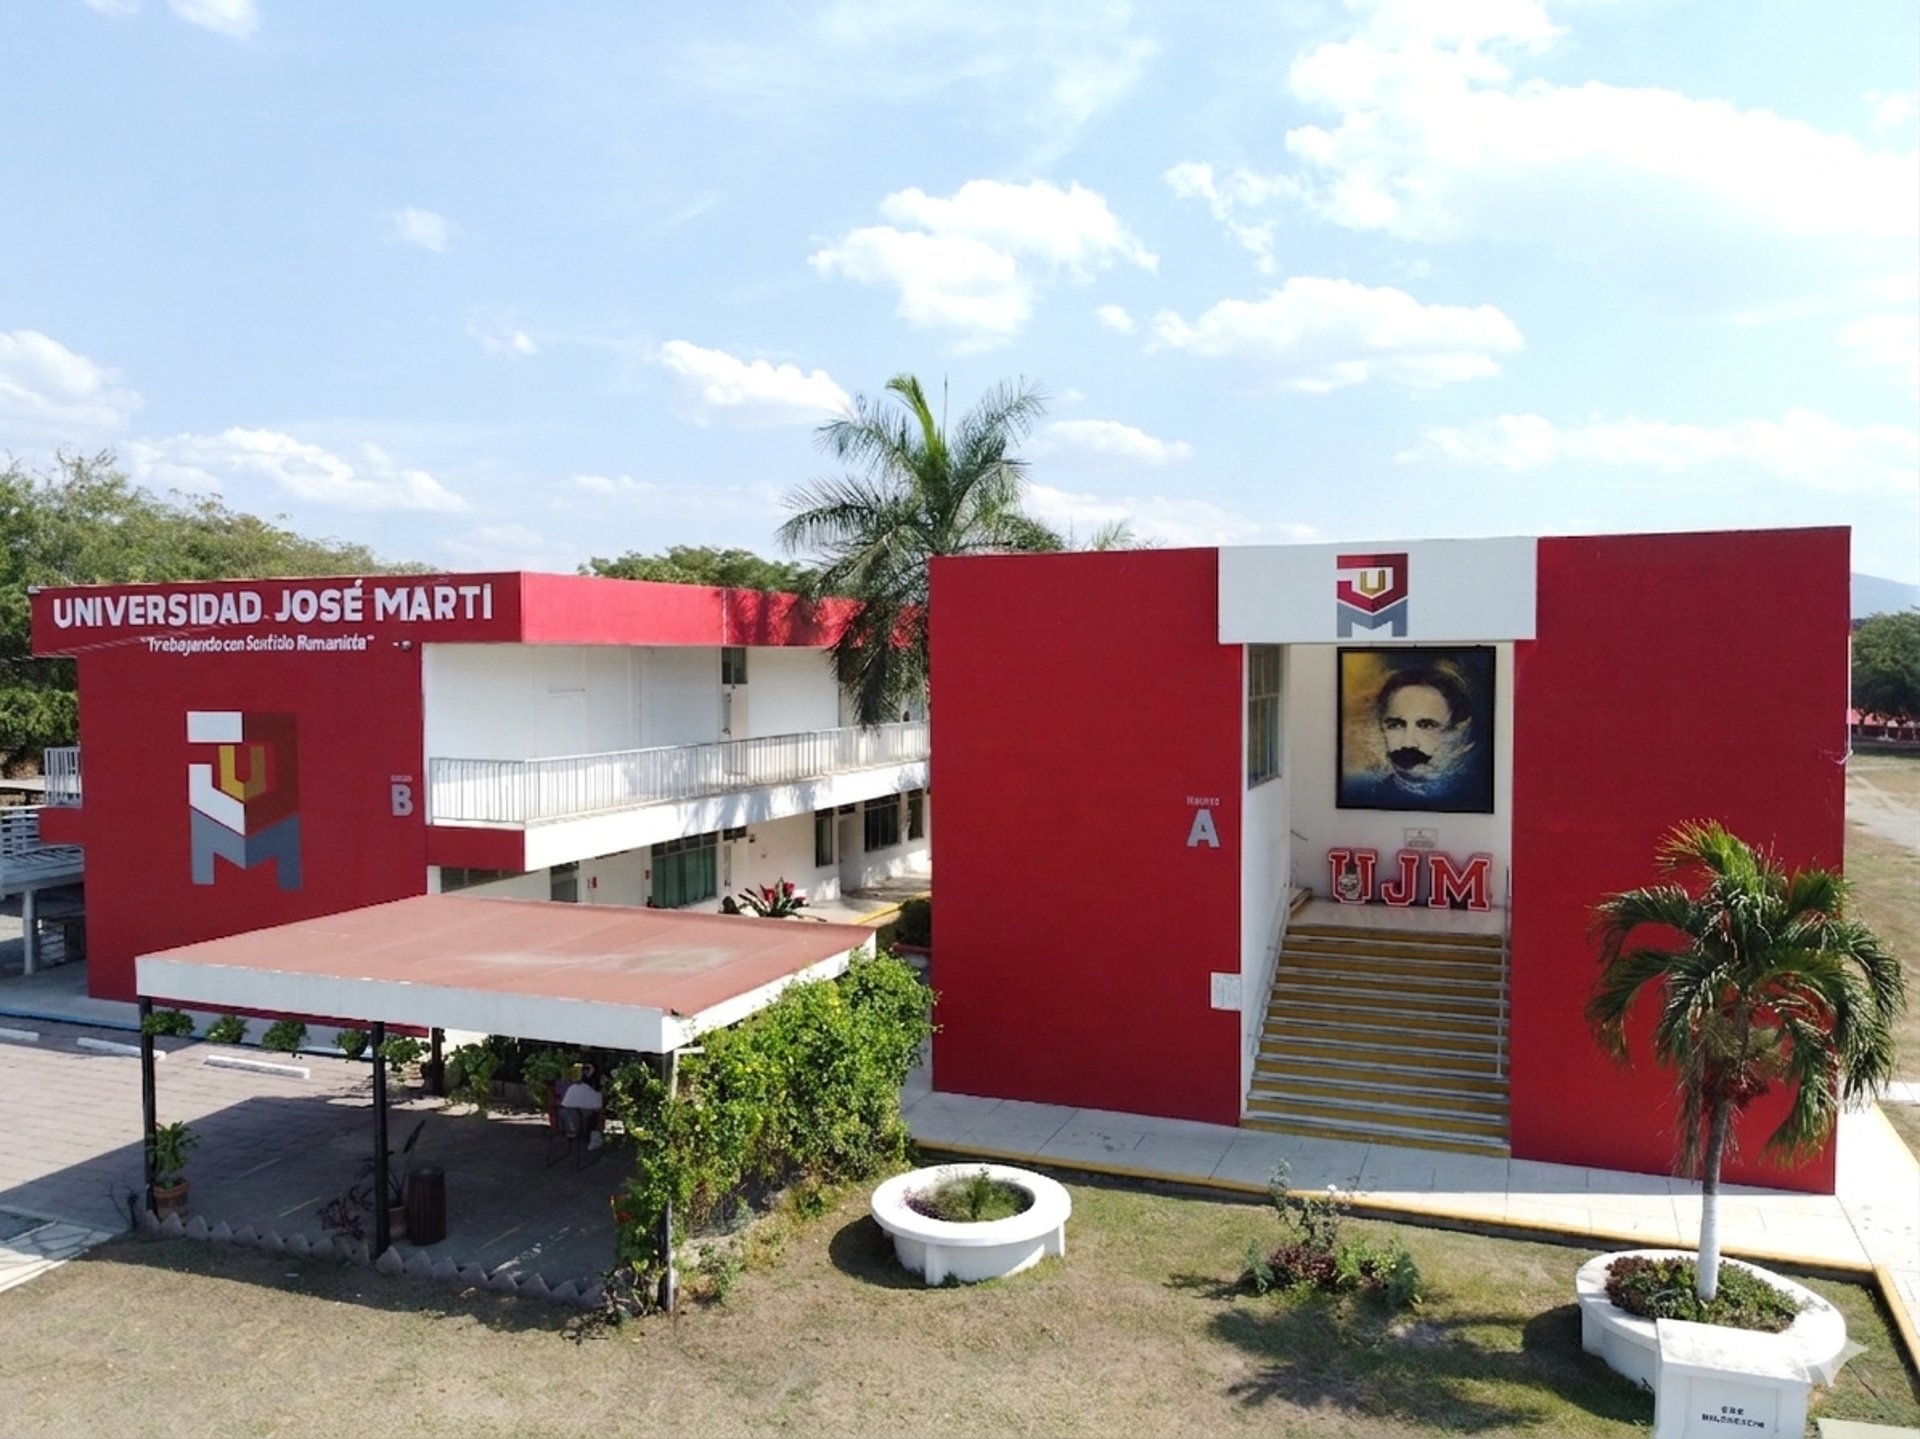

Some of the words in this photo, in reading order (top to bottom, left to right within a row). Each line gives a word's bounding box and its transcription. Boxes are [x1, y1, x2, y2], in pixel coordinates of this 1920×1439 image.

[53, 592, 262, 629] UNIVERSIDAD
[275, 579, 363, 623] JOSÉ
[391, 784, 413, 816] B
[1187, 808, 1220, 848] A
